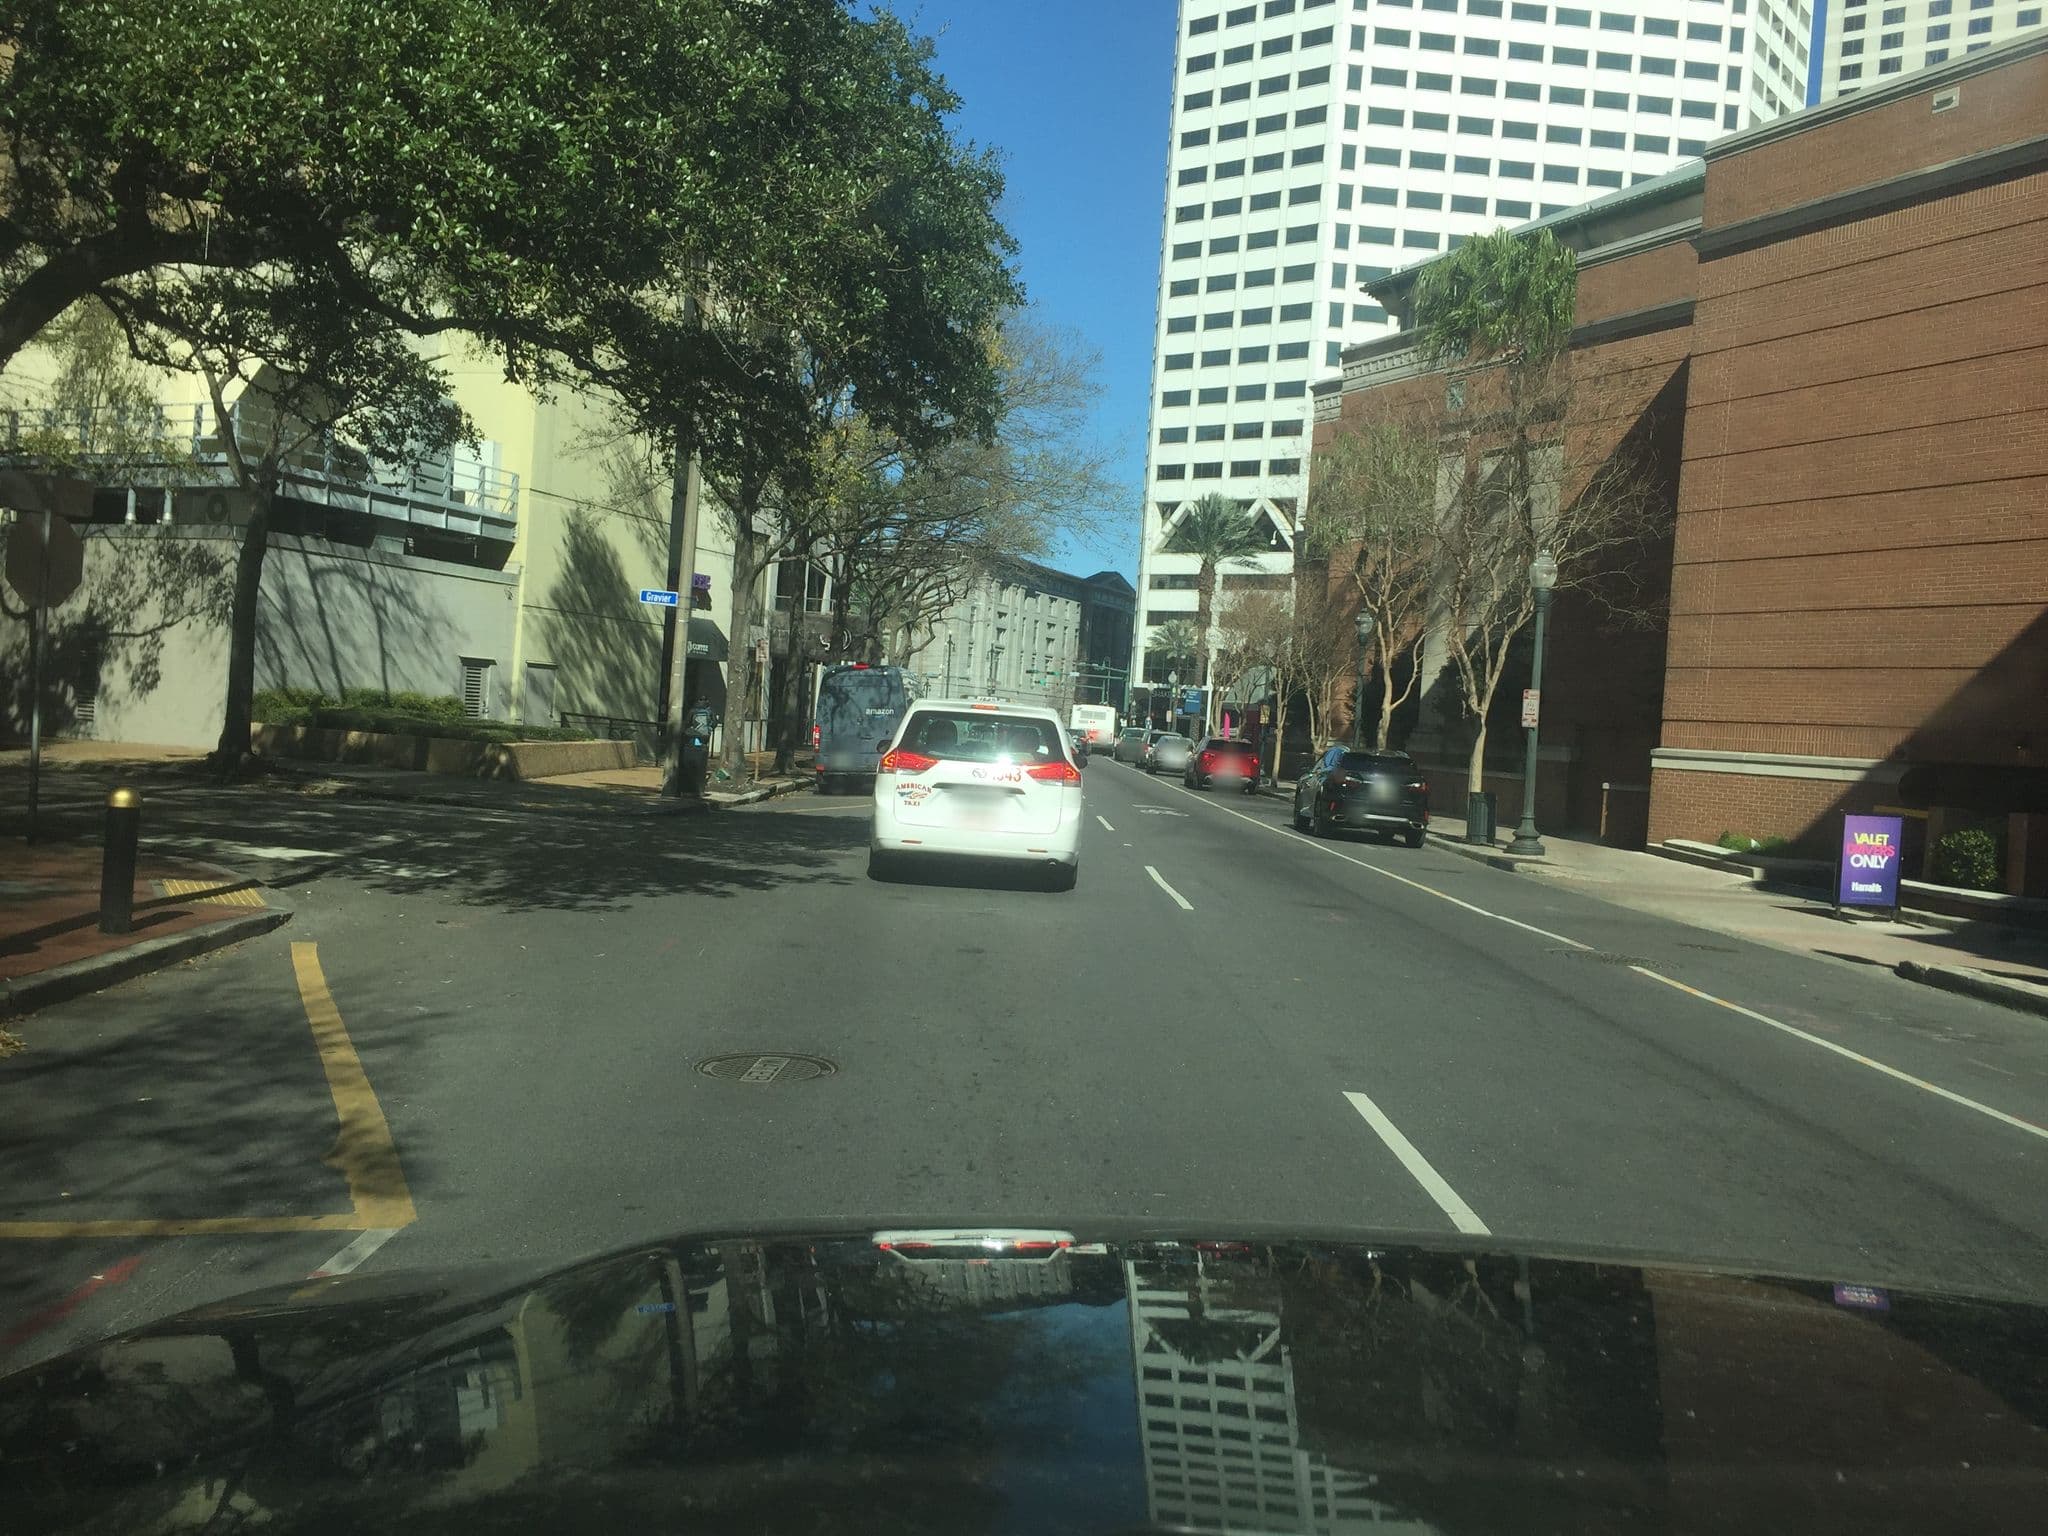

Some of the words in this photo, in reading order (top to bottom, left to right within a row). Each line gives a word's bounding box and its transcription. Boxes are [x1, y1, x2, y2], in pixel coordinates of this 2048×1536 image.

[646, 592, 672, 603] Gravier
[865, 707, 895, 715] amazon
[896, 782, 932, 793] AMERICAN
[1854, 832, 1889, 846] VALET
[1850, 854, 1888, 869] ONLY
